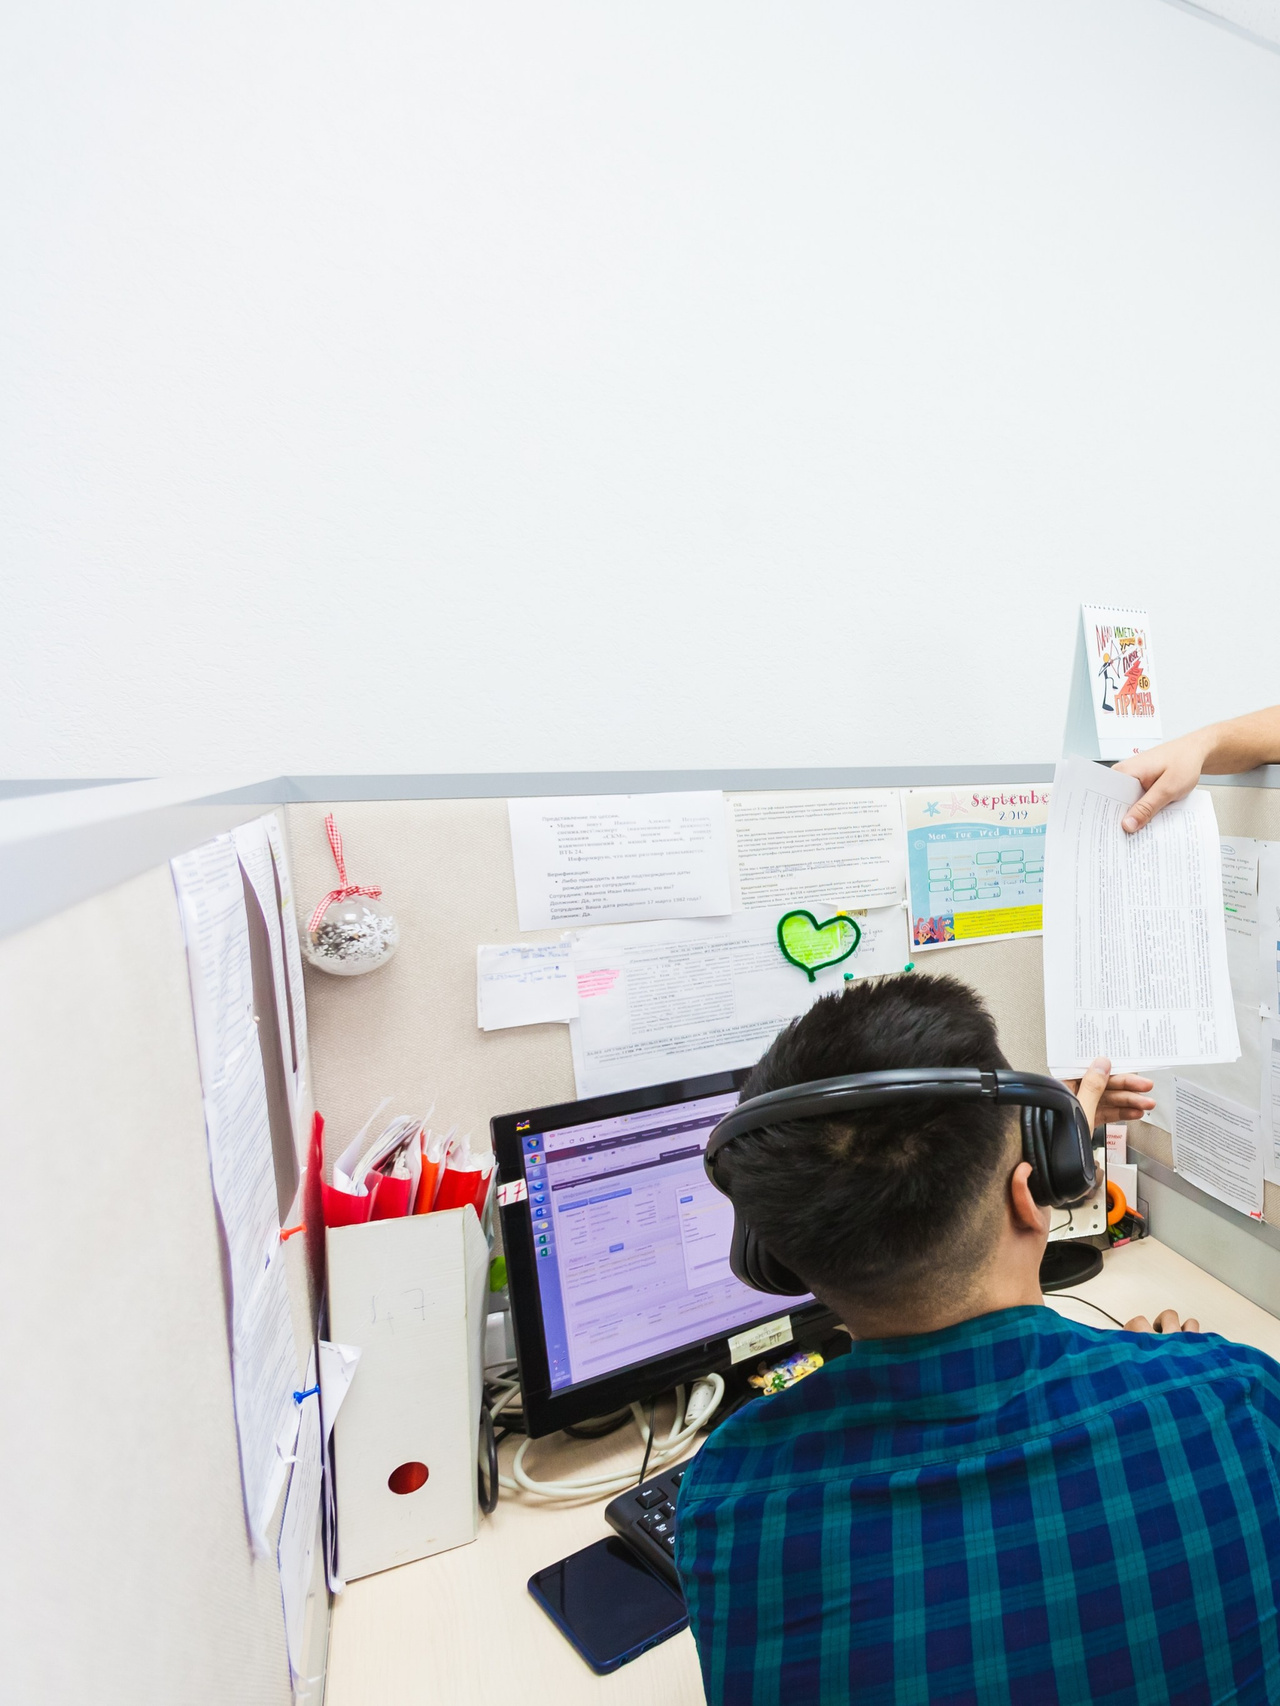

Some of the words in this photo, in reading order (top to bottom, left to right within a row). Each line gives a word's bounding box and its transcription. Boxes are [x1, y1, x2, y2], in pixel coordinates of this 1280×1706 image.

[972, 790, 1050, 810] Septembe
[999, 810, 1028, 820] 2019
[928, 832, 946, 840] Mon
[980, 828, 1000, 837] Wed
